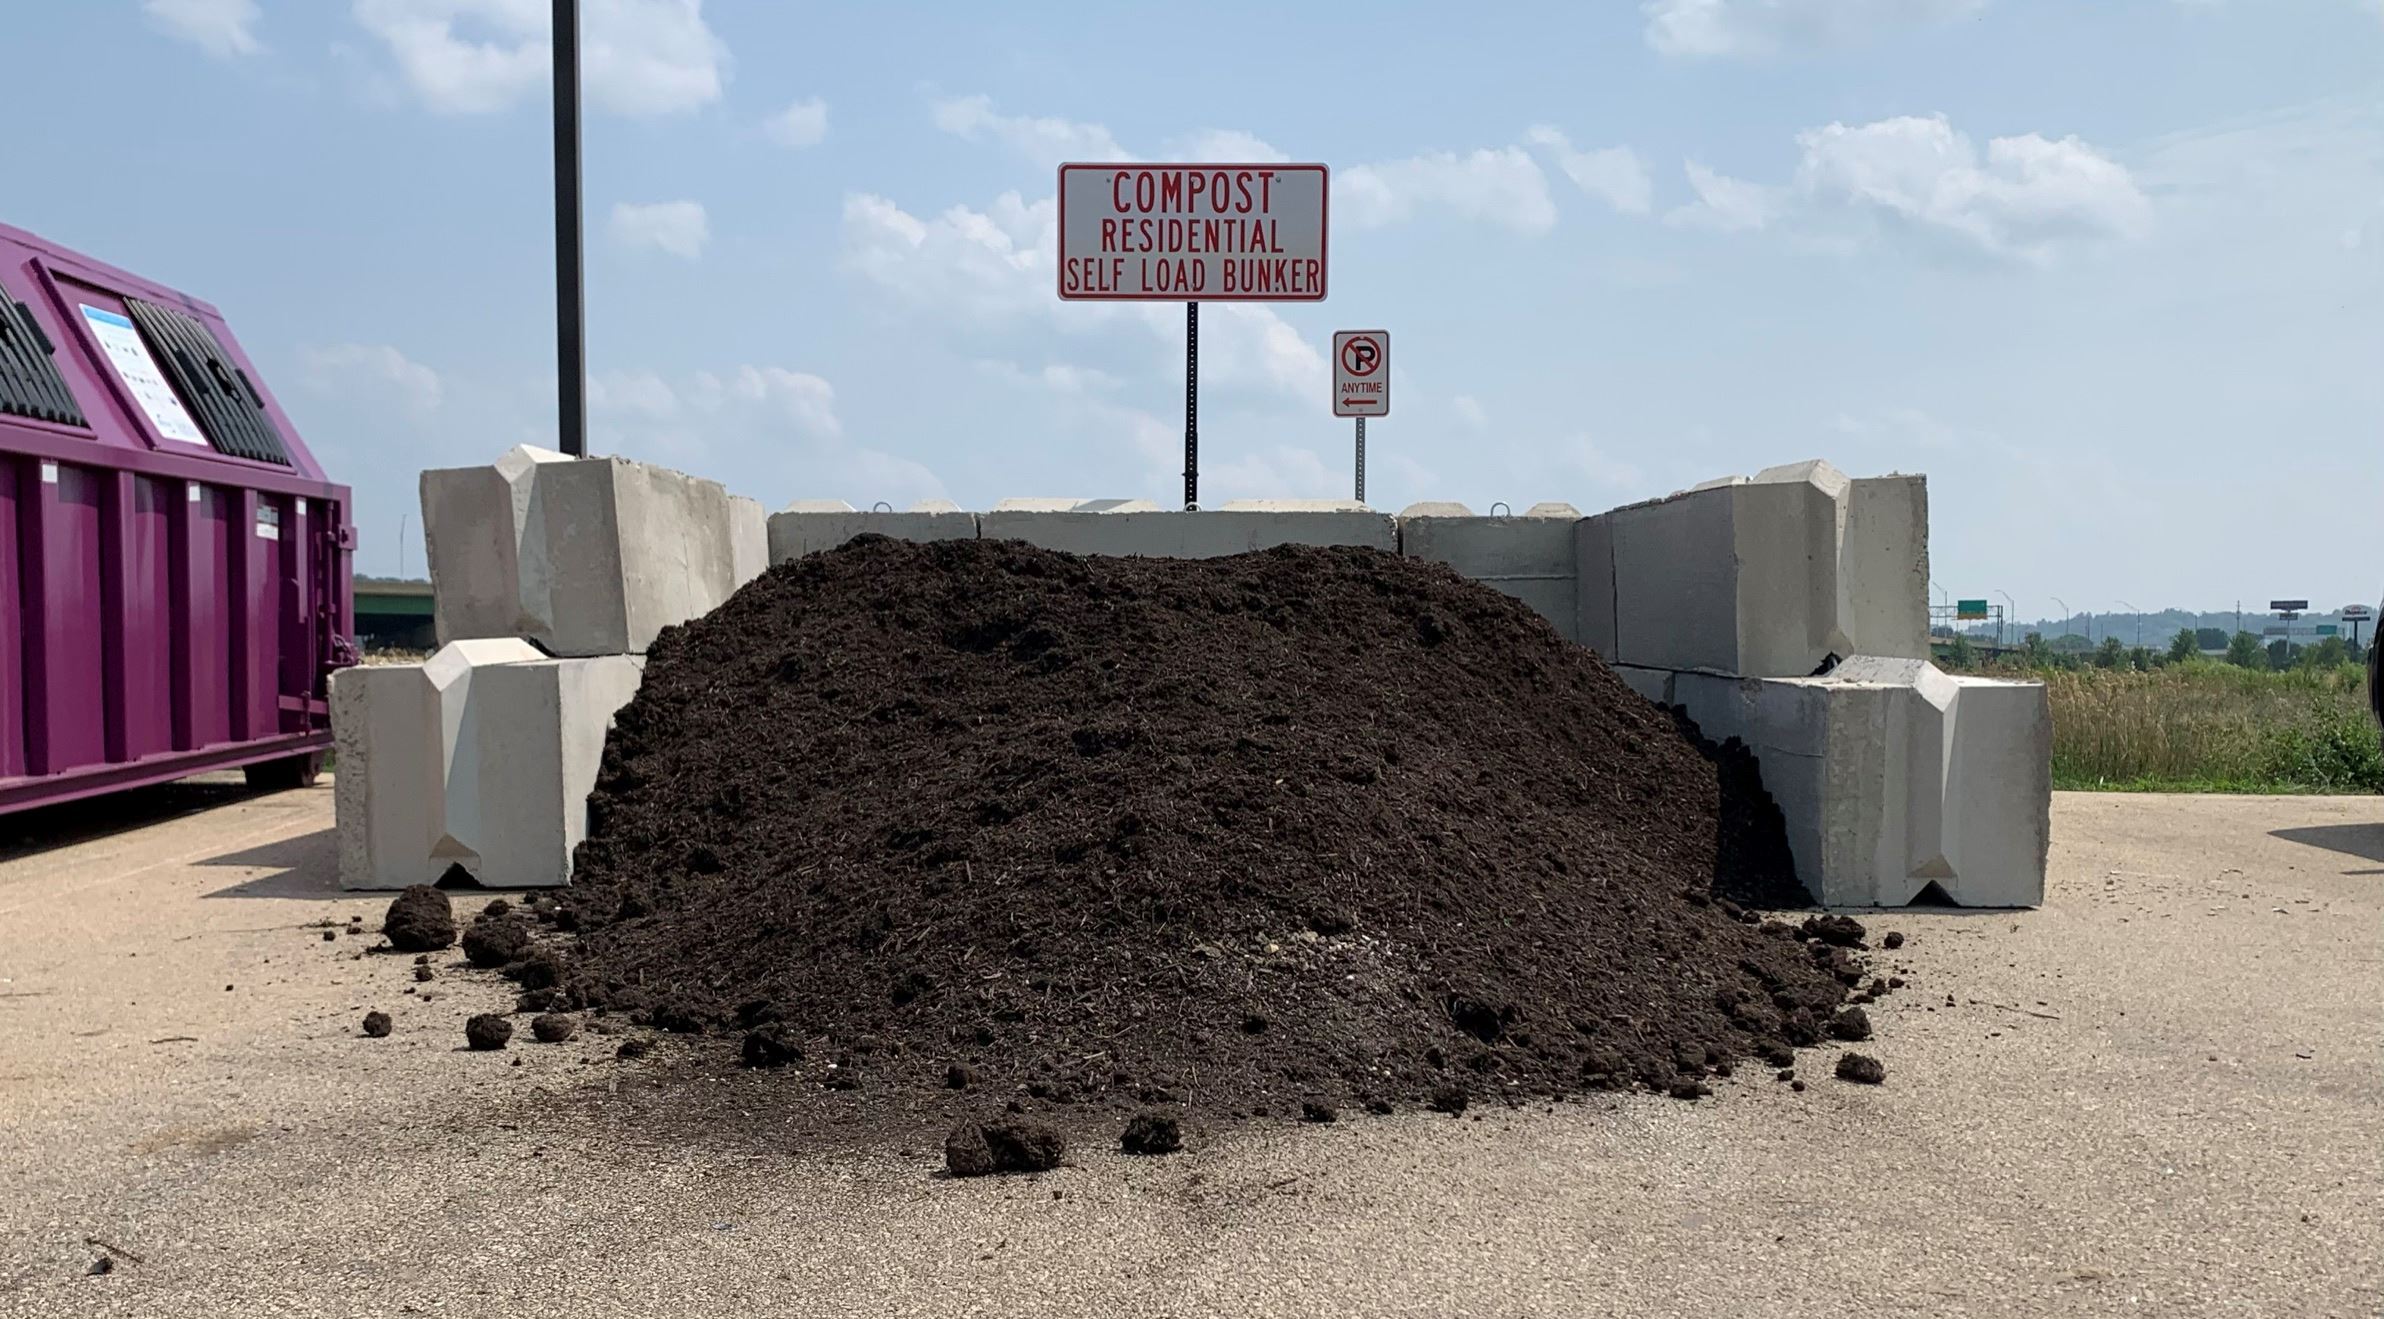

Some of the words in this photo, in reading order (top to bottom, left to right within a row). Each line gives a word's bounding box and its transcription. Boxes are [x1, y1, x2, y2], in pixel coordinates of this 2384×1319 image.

[1113, 171, 1275, 214] COMPOST
[1102, 218, 1284, 253] RESIDENTIAL
[1067, 258, 1125, 292] SELF
[1142, 258, 1205, 292] LOAD
[1223, 258, 1320, 293] BUNKER
[1341, 382, 1383, 394] ANYTIME
